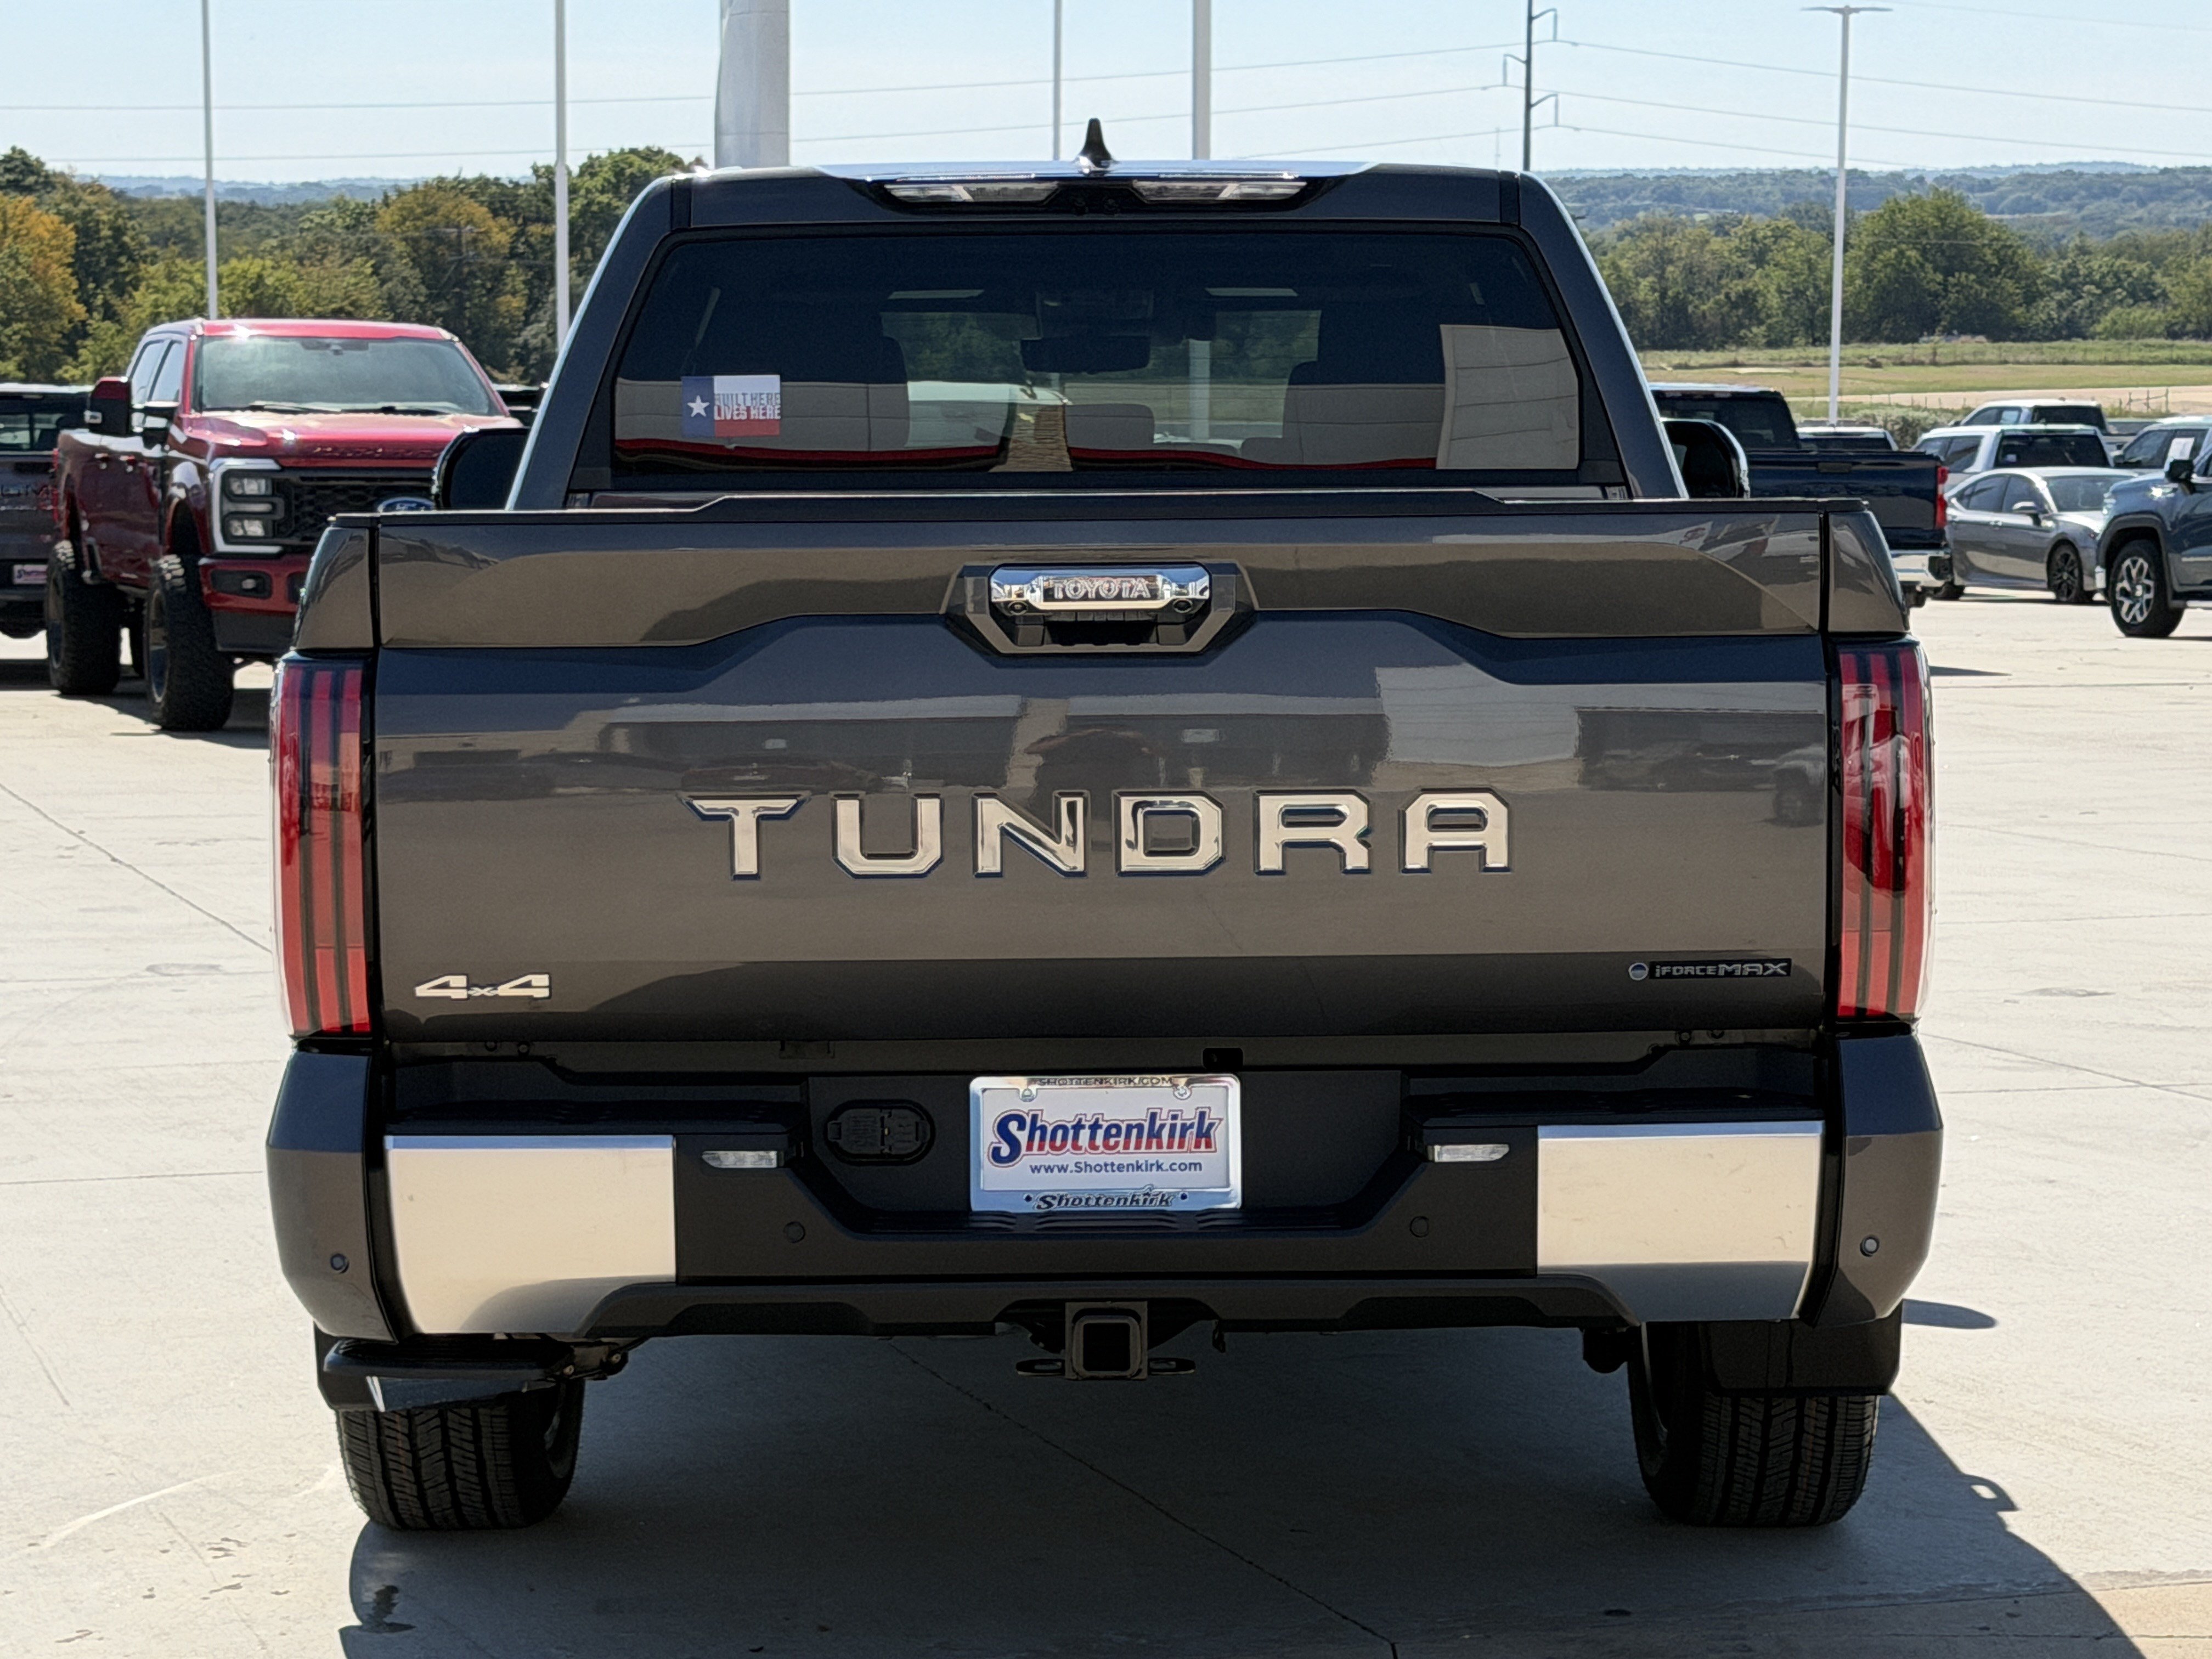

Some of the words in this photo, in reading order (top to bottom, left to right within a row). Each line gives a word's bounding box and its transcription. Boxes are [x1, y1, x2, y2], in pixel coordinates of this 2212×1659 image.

[750, 392, 781, 406] HERE
[714, 405, 748, 421] LIVES
[750, 405, 781, 420] HERE
[1053, 578, 1150, 599] TOYOTA
[681, 790, 1513, 878] TUNDRA
[1038, 1077, 1173, 1086] SHOTTENKIRK.COM
[989, 1108, 1222, 1166] Shottenkirk
[1029, 1160, 1203, 1174] www.Shottenkirk.com
[1035, 1190, 1173, 1210] Shottenkirk
